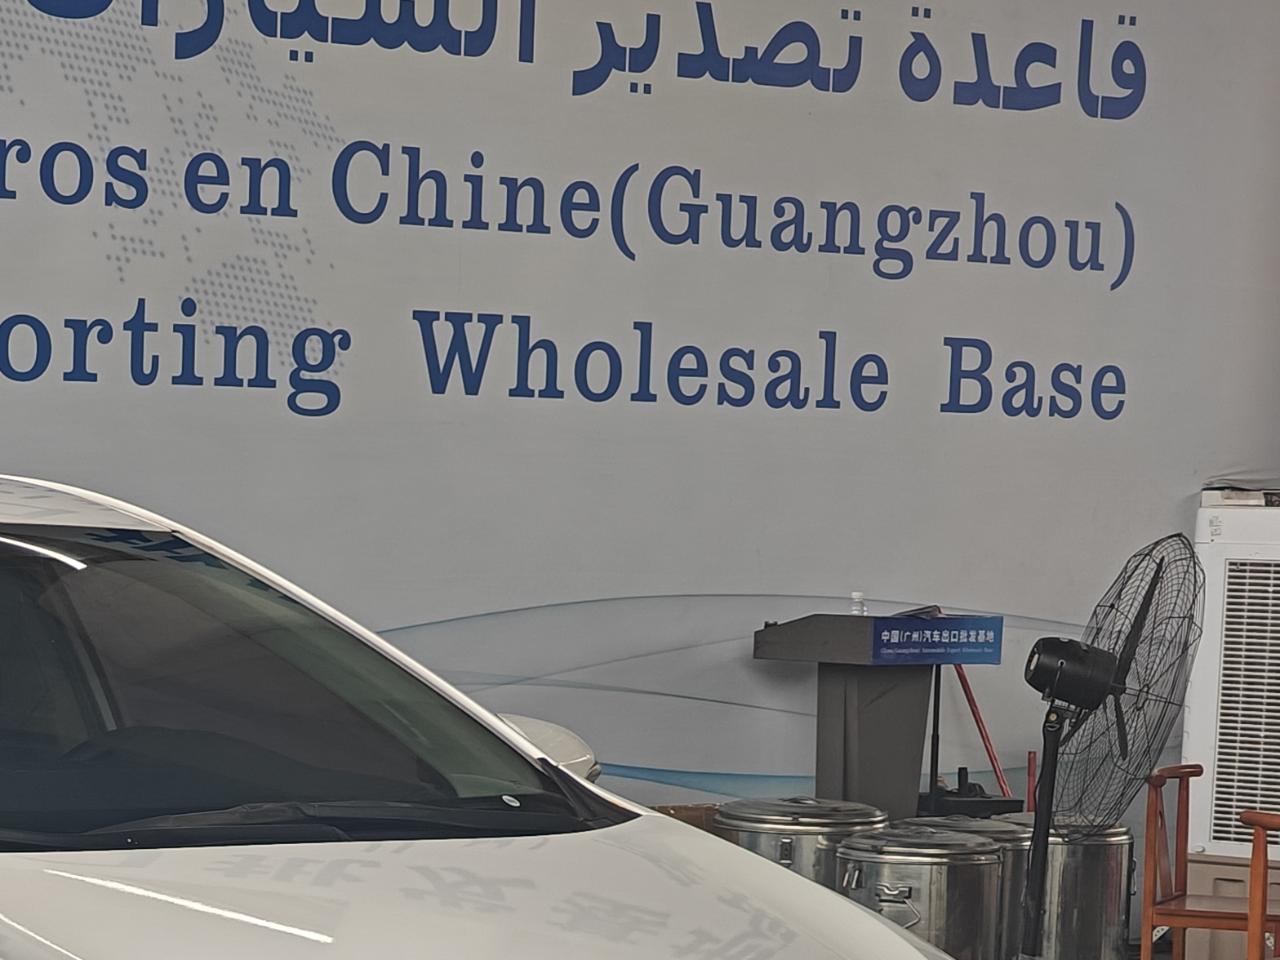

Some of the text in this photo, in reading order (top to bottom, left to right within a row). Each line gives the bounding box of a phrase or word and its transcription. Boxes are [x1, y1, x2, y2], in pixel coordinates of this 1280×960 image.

[571, 2, 863, 96] تصدير
[898, 6, 1146, 120] قاعدة
[183, 152, 297, 218] en
[332, 141, 1136, 291] Chine(Guangzhou)
[413, 309, 889, 412] Wholesale
[940, 336, 1127, 420] Base
